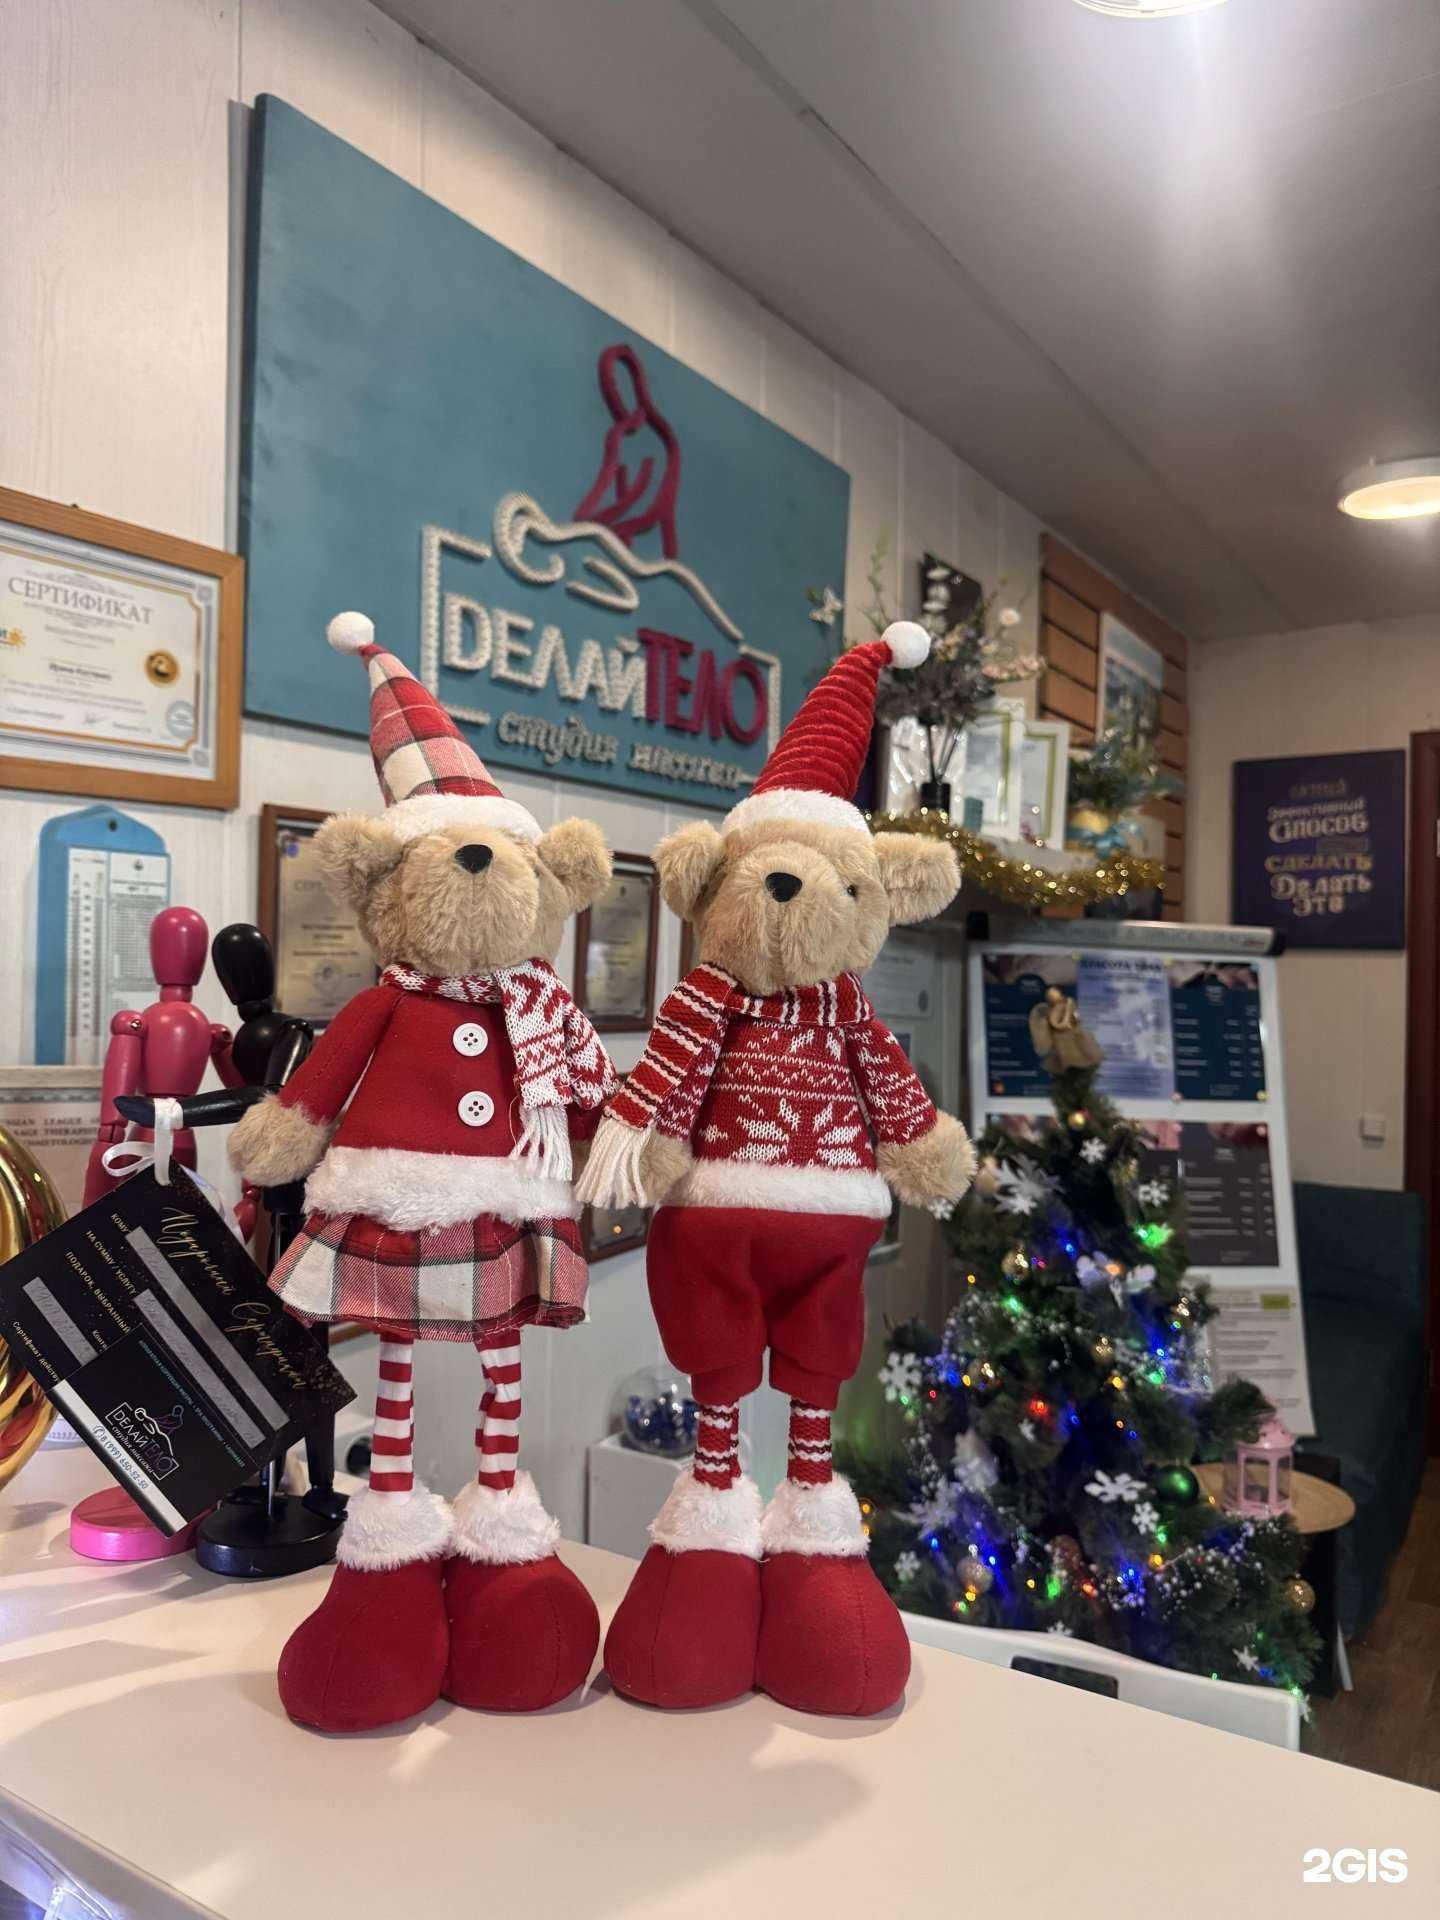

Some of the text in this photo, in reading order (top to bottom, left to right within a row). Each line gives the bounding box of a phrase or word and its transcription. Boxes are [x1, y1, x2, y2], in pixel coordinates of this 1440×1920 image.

[8, 576, 154, 625] СЕРТИФИКАТ
[110, 1212, 129, 1232] КОМУ
[85, 1229, 96, 1242] НА
[93, 1240, 115, 1264] СУММУ
[65, 1251, 130, 1333] ПОДАРОК, ВЫБРАННЫЙ
[103, 1440, 122, 1461] (999)
